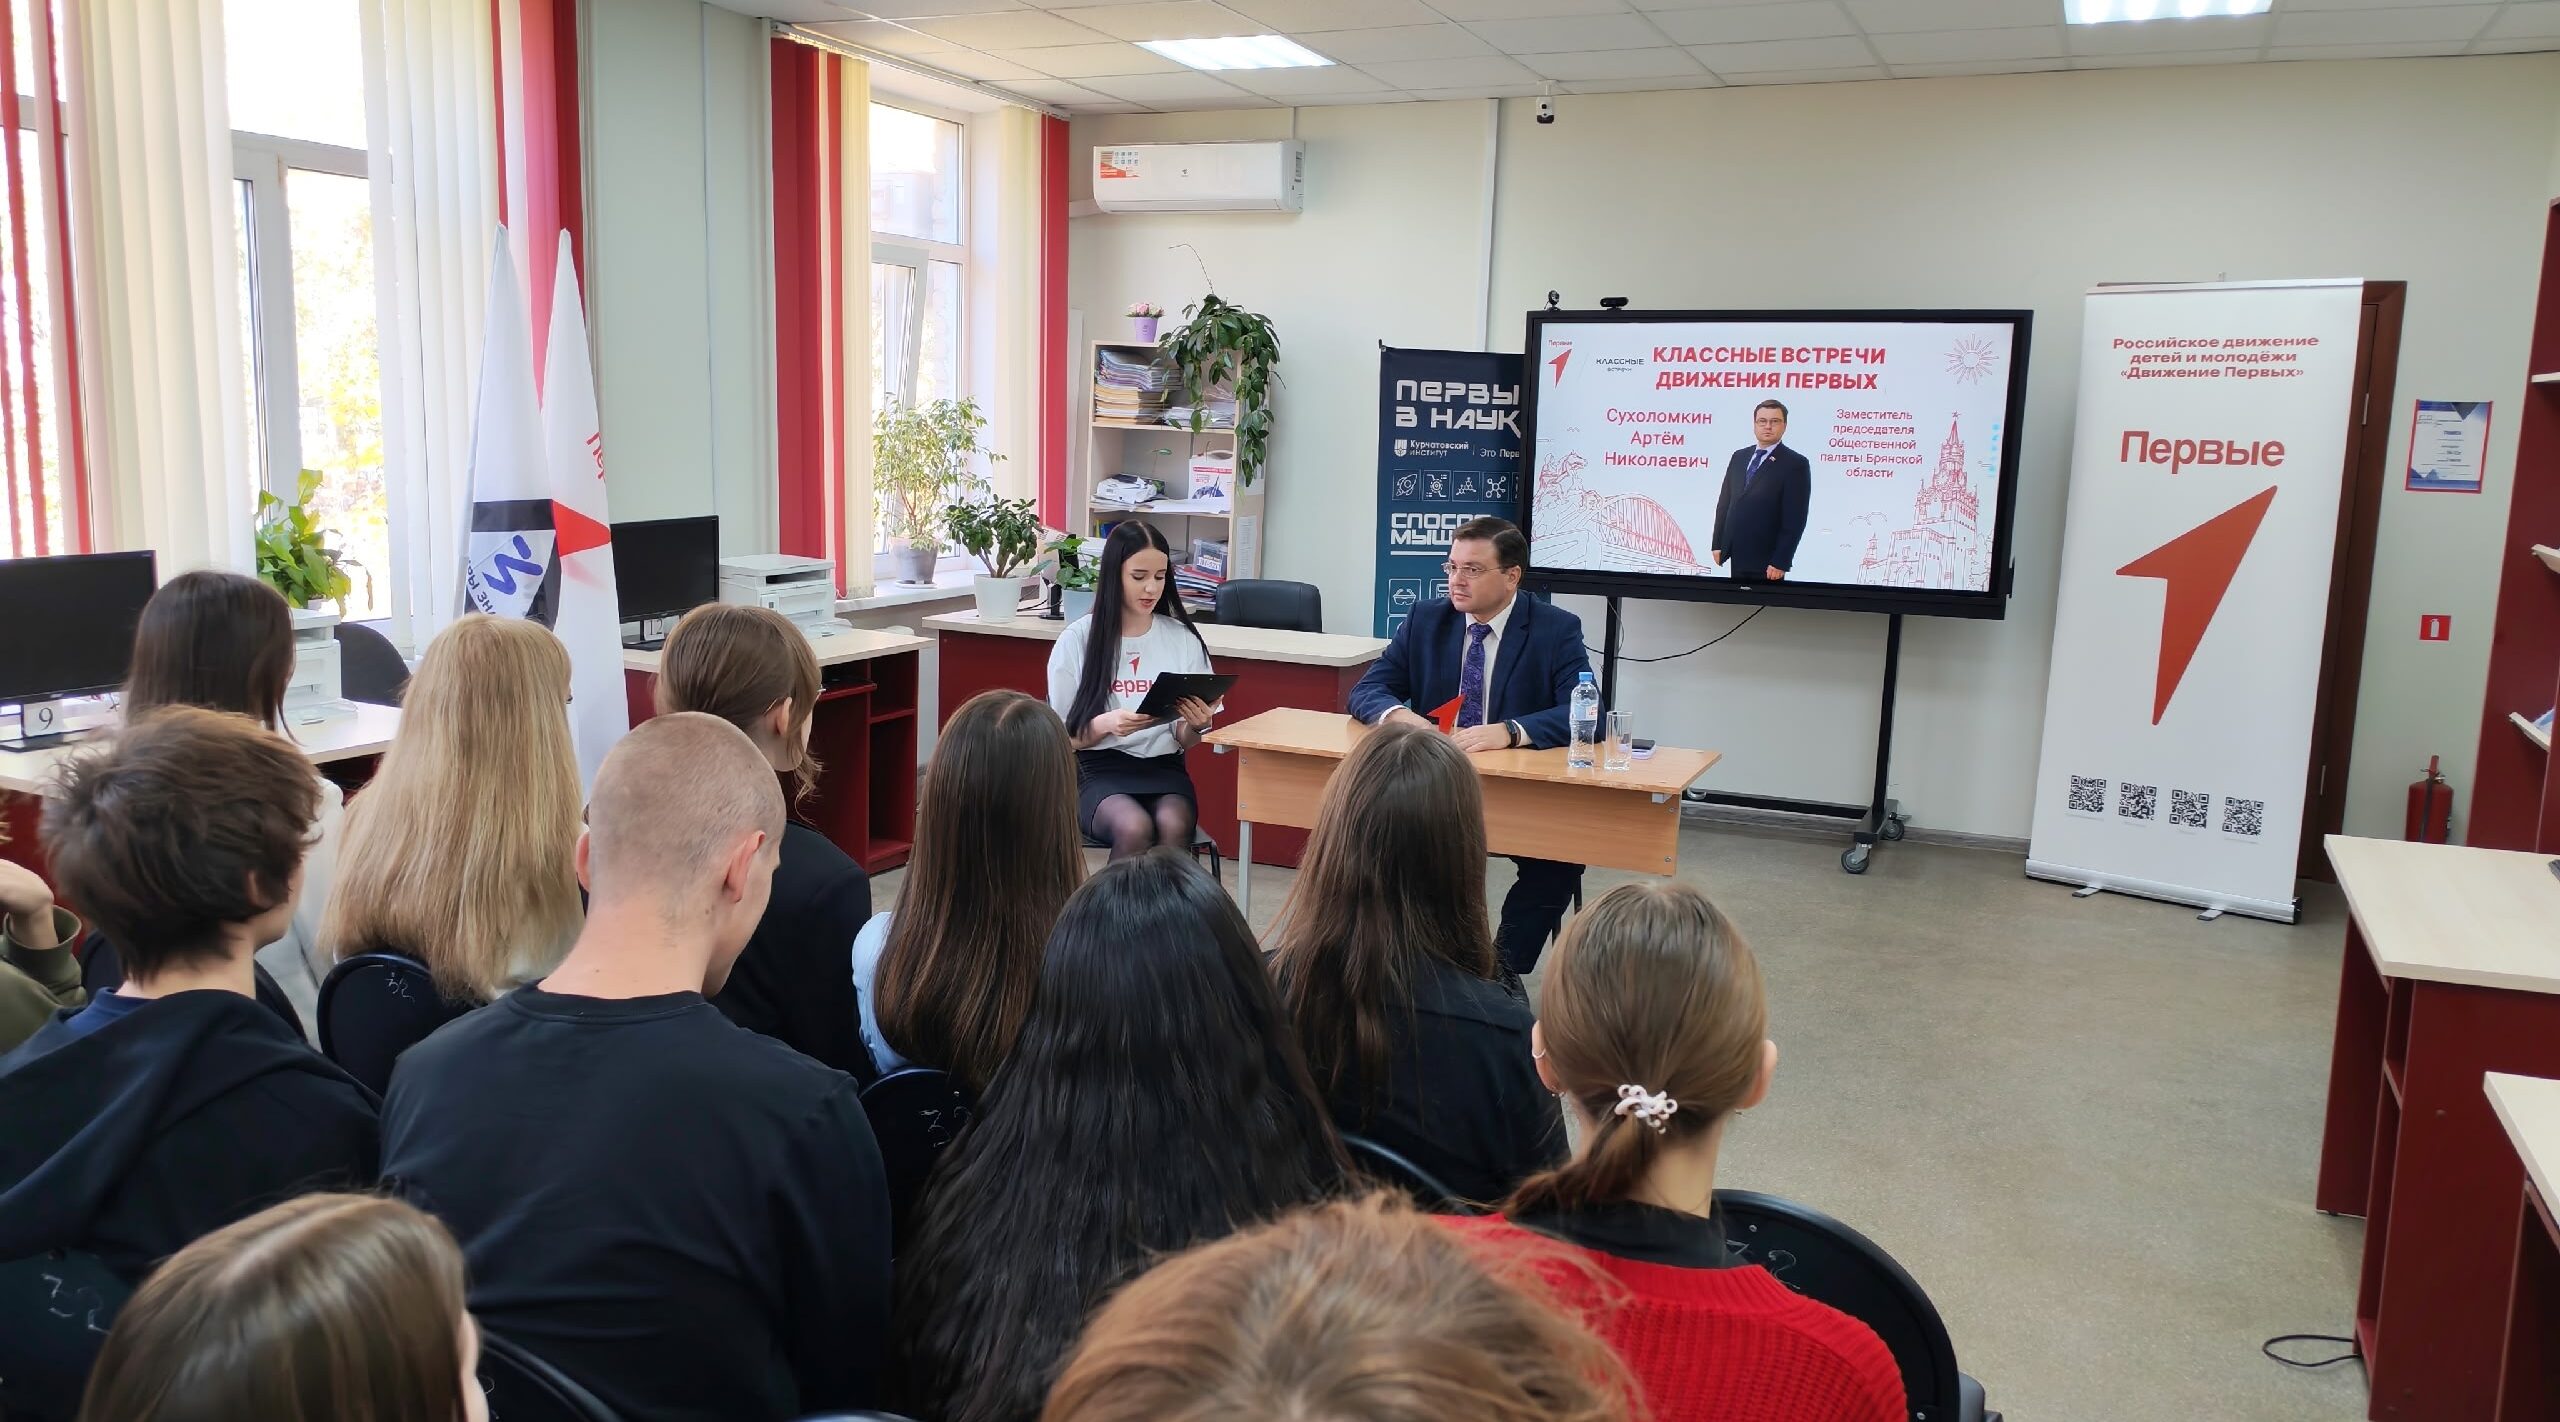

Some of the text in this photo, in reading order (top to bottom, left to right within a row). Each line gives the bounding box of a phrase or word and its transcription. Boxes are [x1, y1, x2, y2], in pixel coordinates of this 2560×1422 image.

[2113, 336, 2320, 349] Российское движение
[1595, 358, 1645, 366] КЛАССНЫЕ
[1653, 347, 1886, 364] КЛАССНЫЕ ВСТРЕЧИ
[2130, 351, 2298, 365] детей и молодёжи
[2120, 366, 2304, 380] «Движение Первых»
[1656, 372, 1878, 390] ДВИЖЕНИЯ ПЕРВЫХ
[1396, 379, 1519, 406] ПЕРВЫ
[1606, 408, 1712, 426] Сухоломкин
[1836, 408, 1913, 420] Заместитель
[1395, 406, 1521, 438] В НАУК
[1833, 425, 1915, 435] председателя
[1410, 439, 1469, 451] Курчатовский
[1630, 430, 1685, 447] Артём
[1828, 437, 1917, 449] Общественной
[1479, 448, 1520, 460] Это Перв
[1604, 451, 1710, 469] Николаевич
[1820, 453, 1923, 465] палаты Брянской
[2120, 430, 2285, 475] Первые
[1846, 467, 1894, 478] области
[1390, 529, 1453, 546] МЫШ
[648, 619, 663, 635] 12
[38, 707, 54, 731] 9
